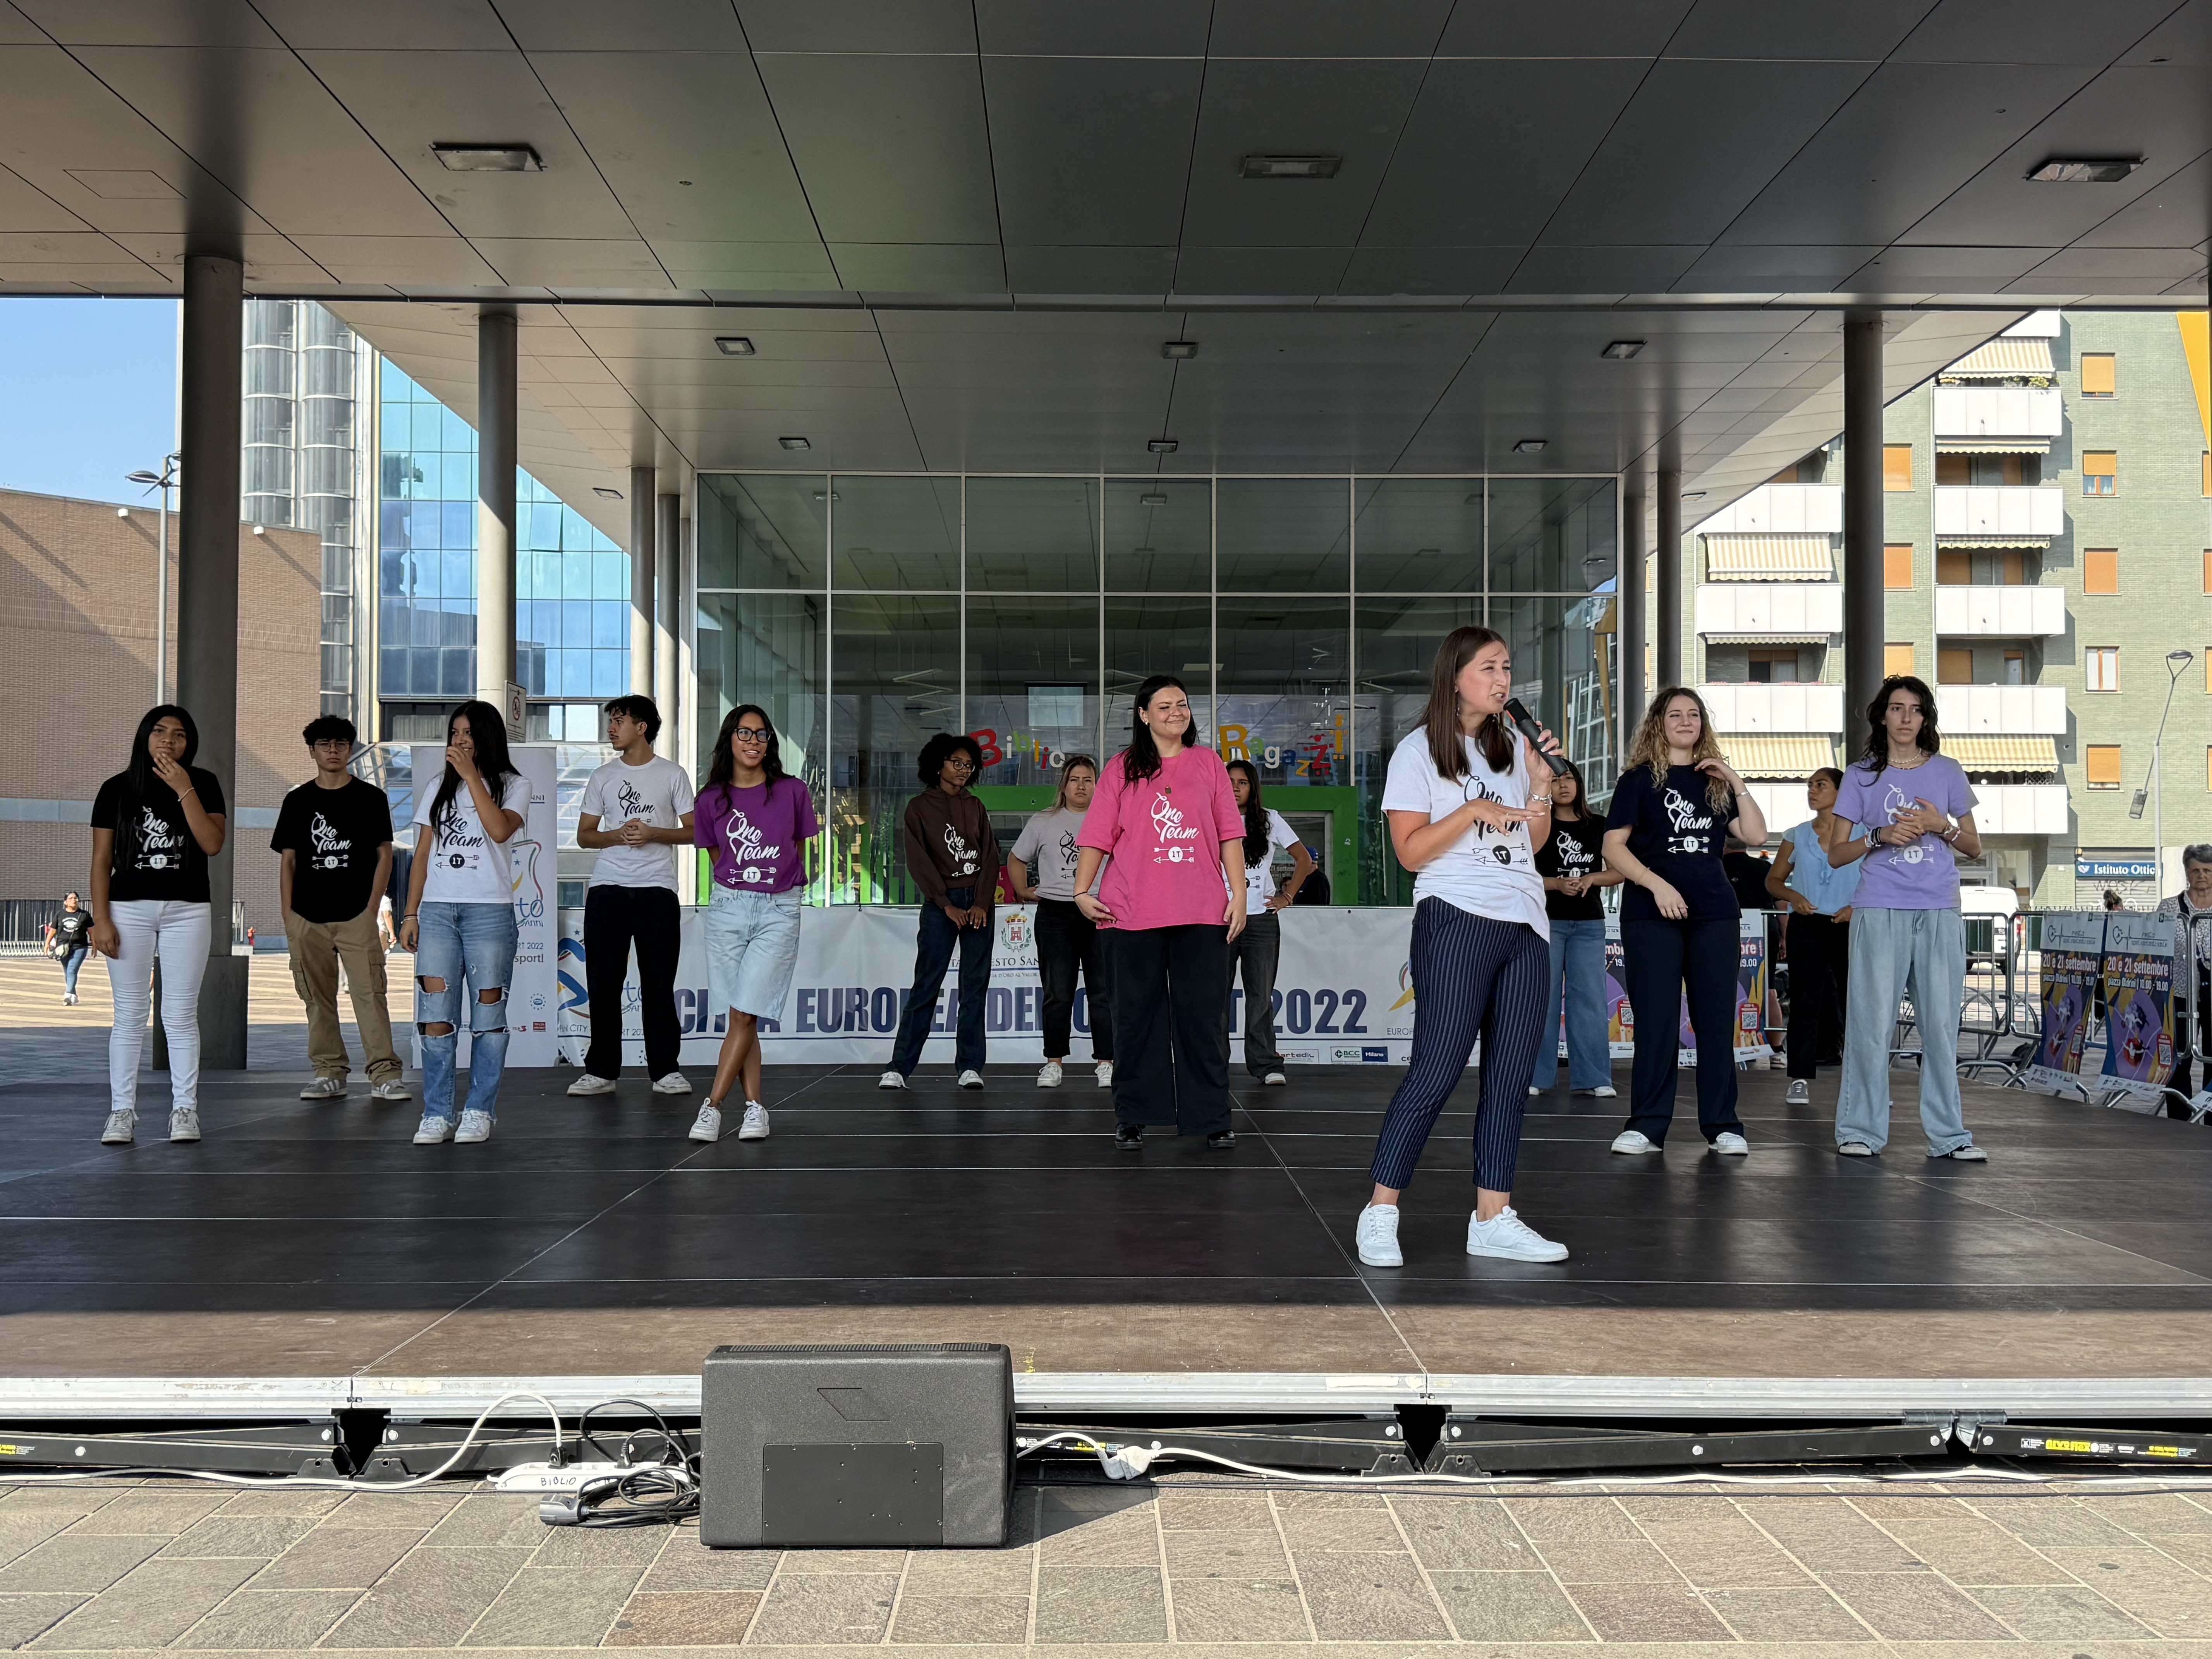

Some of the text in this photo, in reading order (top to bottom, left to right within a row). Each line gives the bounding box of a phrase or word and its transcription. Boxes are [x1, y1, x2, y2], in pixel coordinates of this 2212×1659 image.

[1219, 714, 1348, 777] Ragazzi
[618, 780, 641, 802] One
[1664, 788, 1695, 814] One
[620, 799, 655, 818] Team
[1151, 792, 1184, 823] One
[311, 812, 338, 838] One
[726, 809, 763, 843] One
[1153, 817, 1199, 843] Team
[1668, 806, 1712, 833] Team
[312, 833, 352, 854] Team
[440, 824, 484, 849] Team
[1557, 831, 1583, 851] One
[730, 836, 780, 865] Team
[1559, 846, 1594, 866] Team
[2094, 864, 2155, 874] Istituto Ottic
[991, 958, 1016, 966] ESTO
[2043, 953, 2097, 972] 20 e 21 settembre
[2107, 956, 2168, 976] 20 e 21 settembre
[1271, 989, 1367, 1034] 2022
[570, 1024, 588, 1032] CITY
[541, 1476, 576, 1486] BIBLIO
